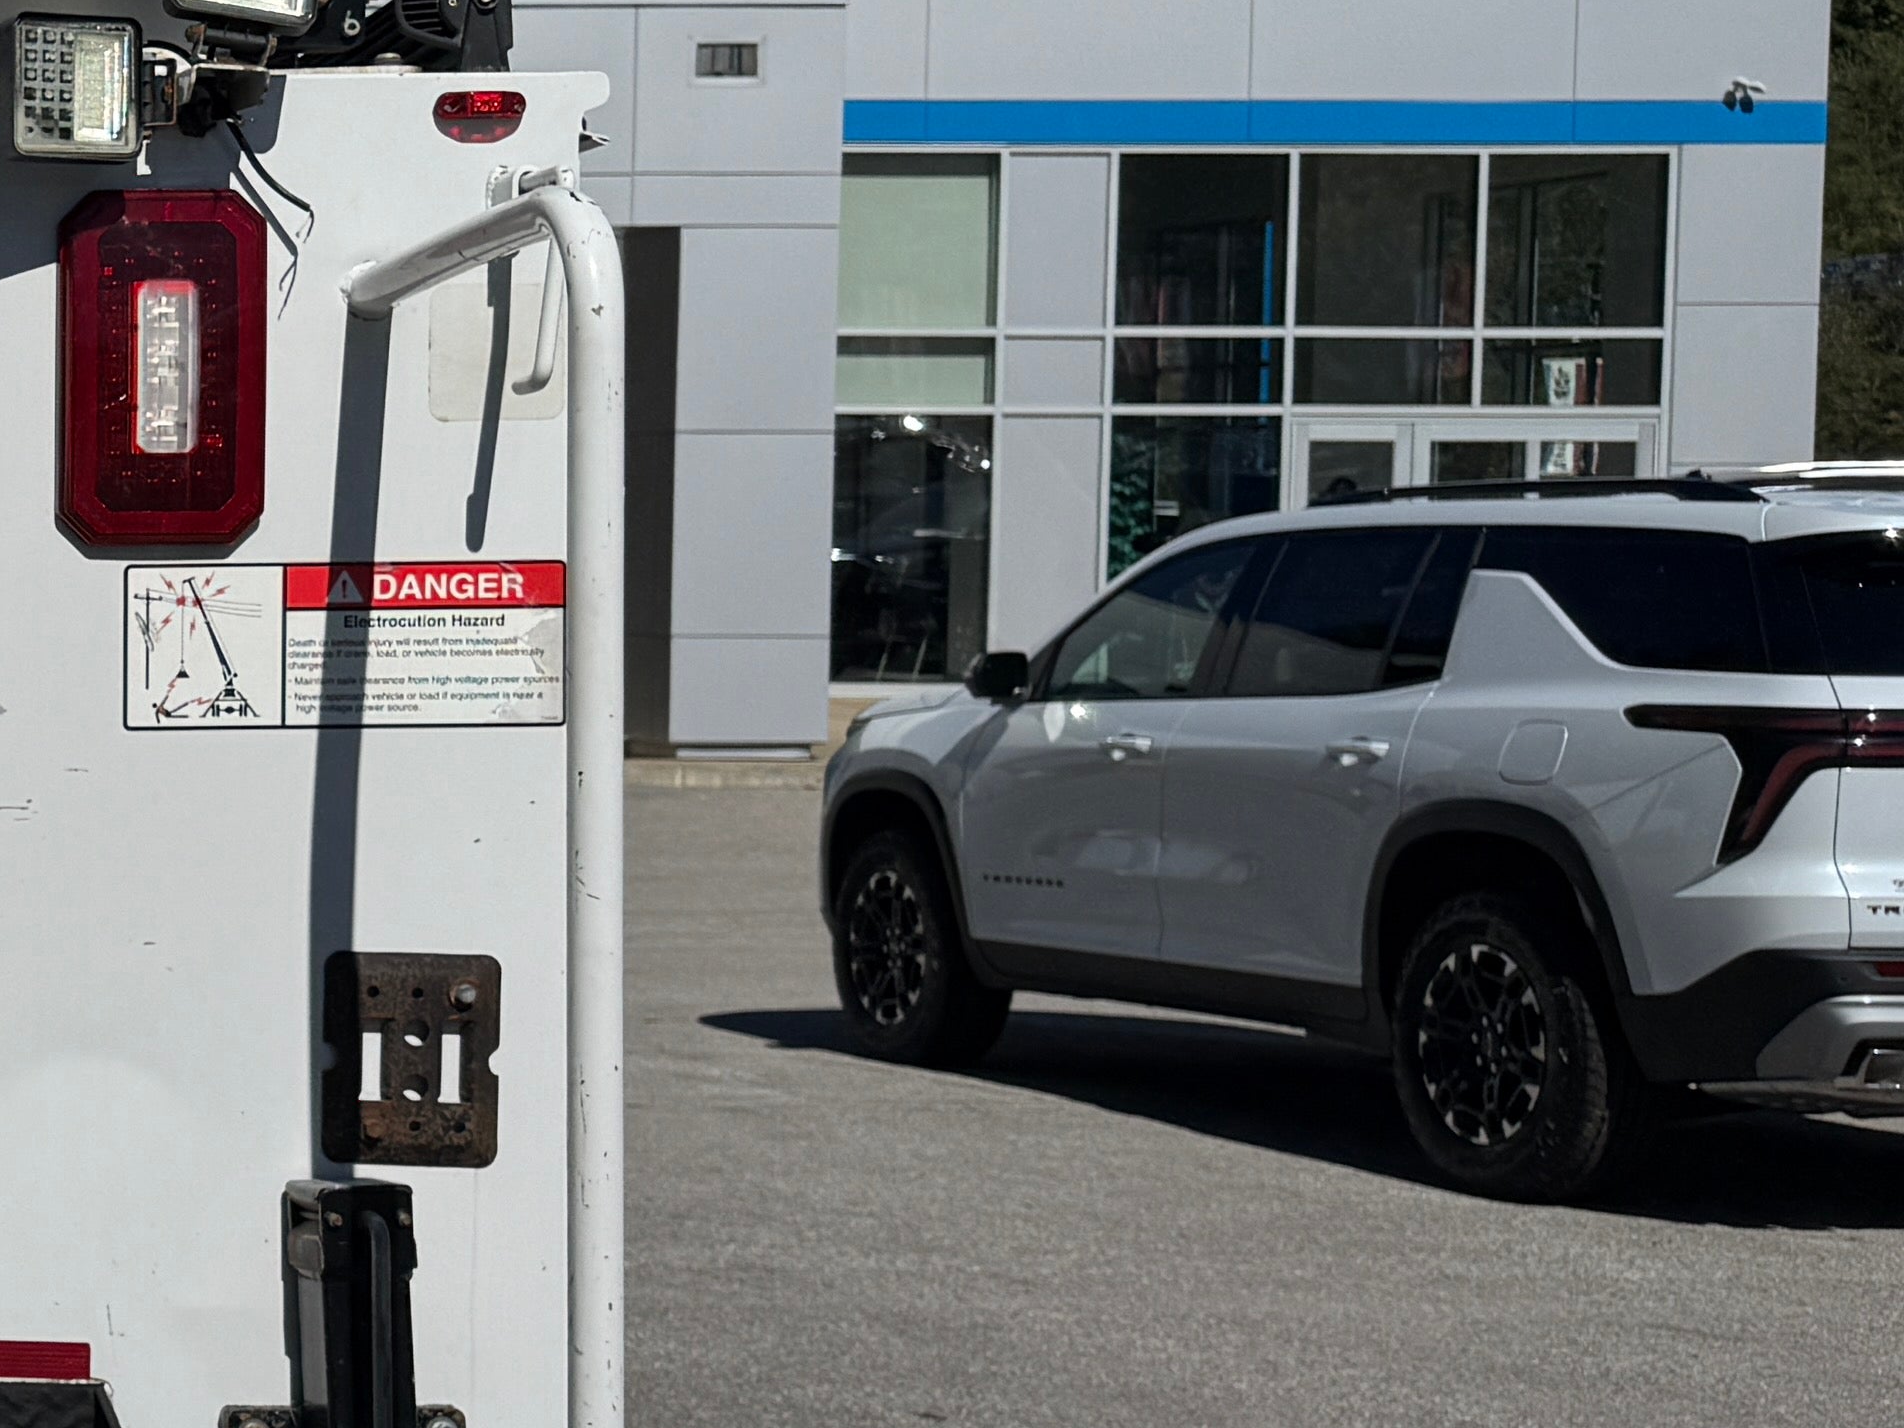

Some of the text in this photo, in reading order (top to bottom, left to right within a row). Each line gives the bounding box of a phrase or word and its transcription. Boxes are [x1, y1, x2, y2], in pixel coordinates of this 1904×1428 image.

[373, 572, 525, 600] DANGER
[343, 613, 505, 629] Electrocution Hazard
[413, 638, 439, 646] result
[442, 637, 463, 645] from
[414, 649, 447, 657] vehicle
[450, 649, 492, 657] becomes
[408, 676, 429, 684] from
[432, 676, 452, 686] high
[454, 676, 489, 686] voltage
[491, 676, 520, 685] power
[371, 692, 404, 700] vehicle
[419, 692, 440, 700] load
[450, 692, 499, 701] equipment
[296, 704, 316, 714] high
